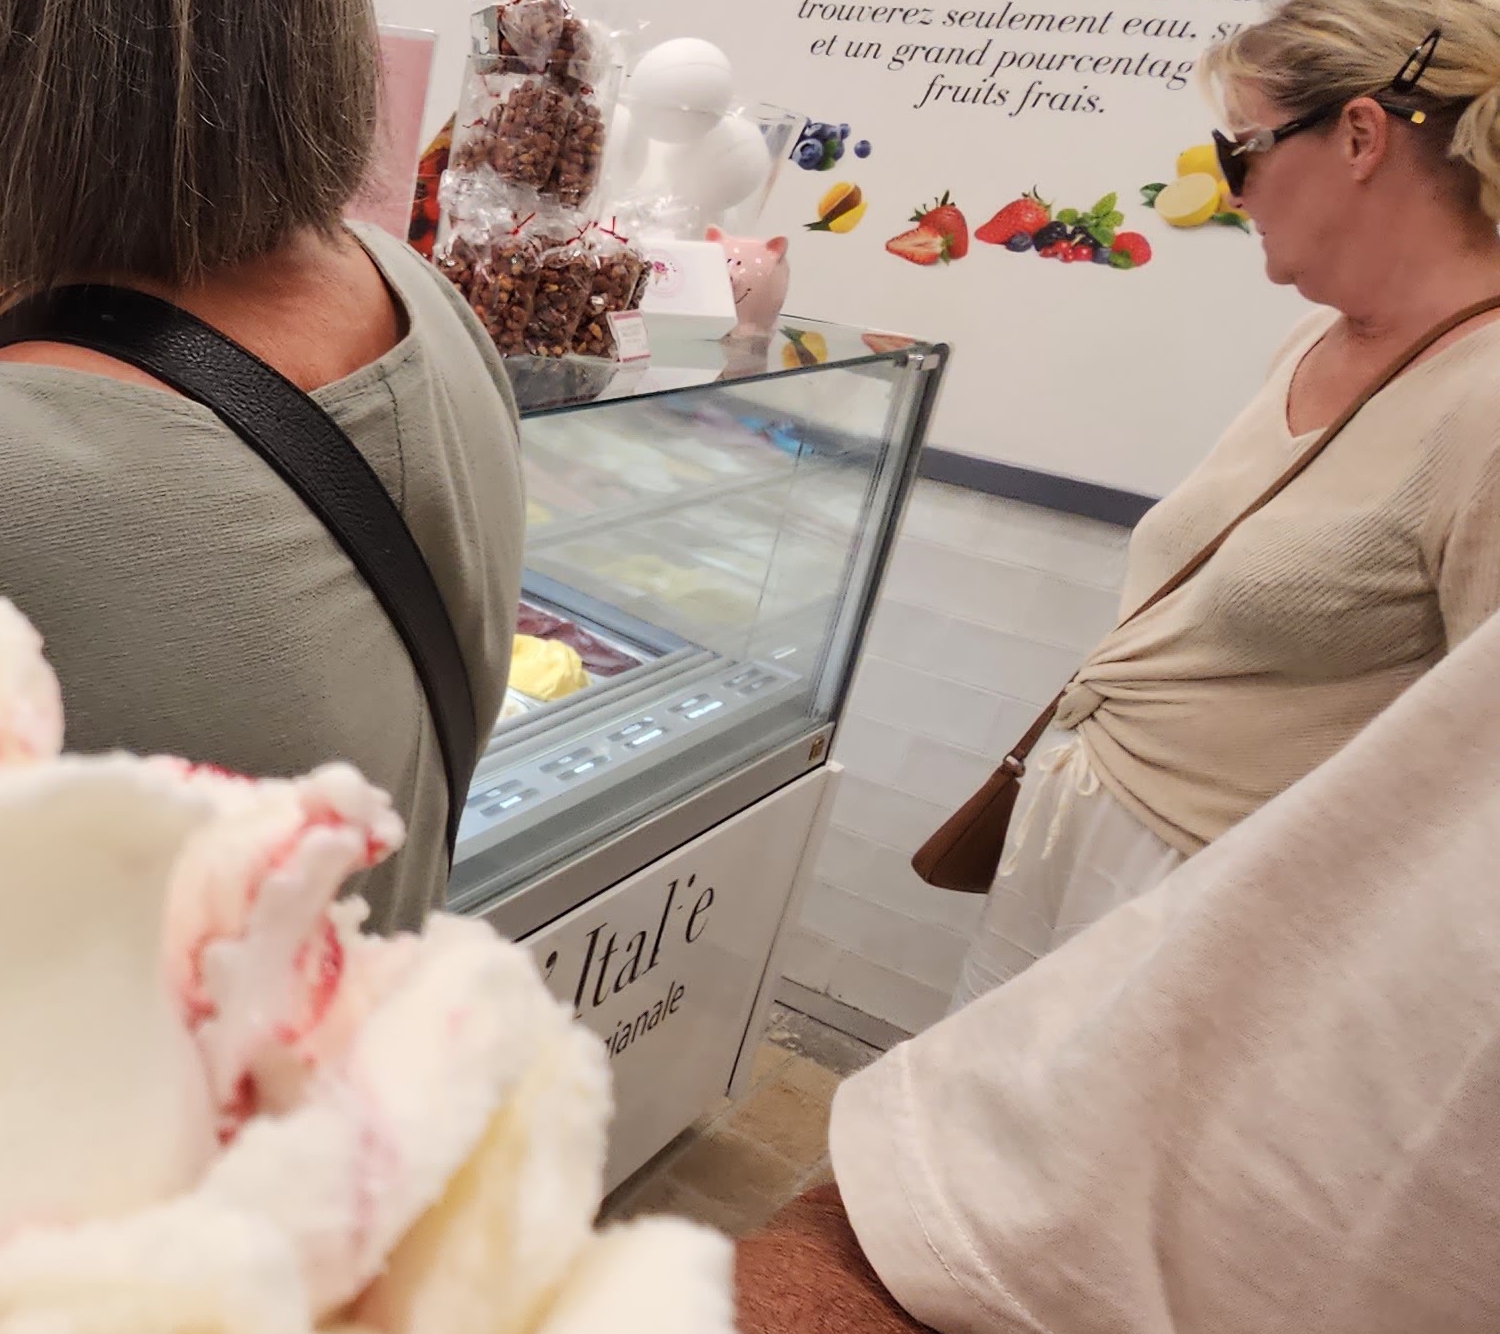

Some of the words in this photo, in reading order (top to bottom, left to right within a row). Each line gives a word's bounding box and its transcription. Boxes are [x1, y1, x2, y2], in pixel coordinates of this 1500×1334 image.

[942, 2, 1114, 36] seulement
[810, 35, 837, 57] et
[845, 40, 883, 60] un
[887, 39, 994, 71] grand
[989, 49, 1196, 91] pourcentag
[913, 74, 1009, 109] fruits
[1009, 81, 1106, 116] frais.
